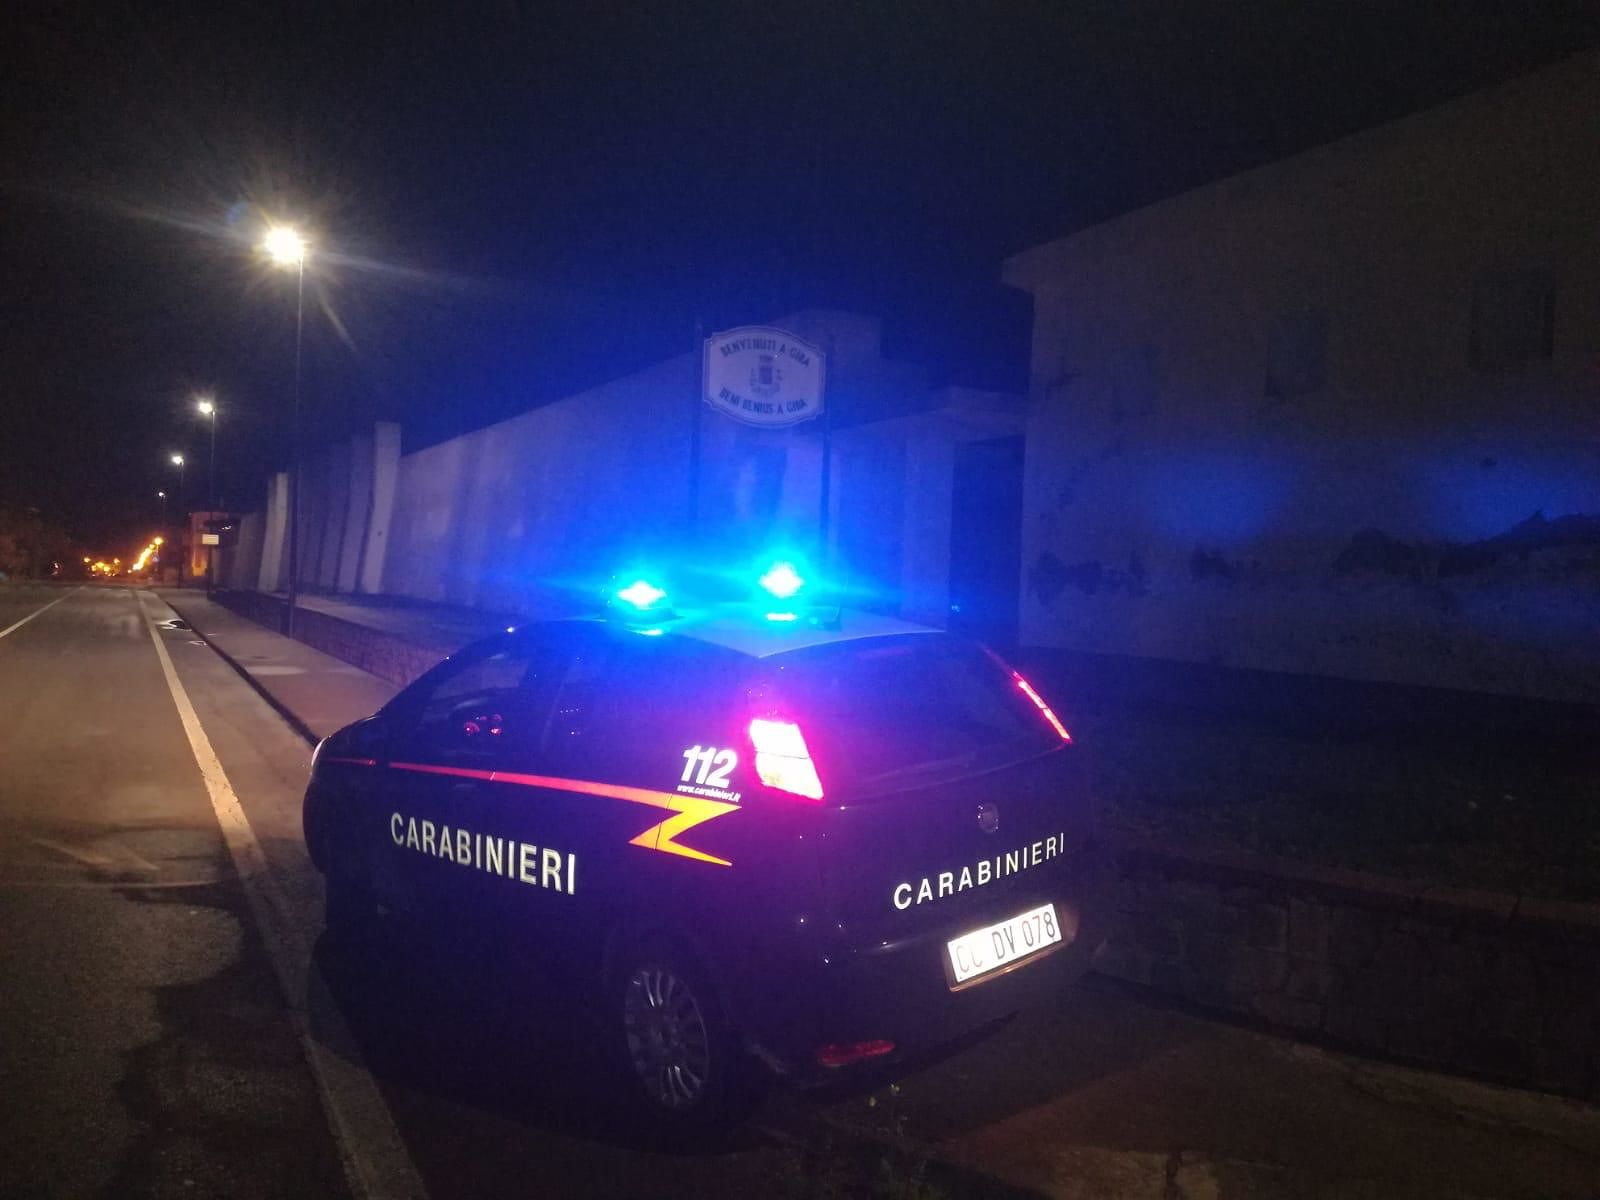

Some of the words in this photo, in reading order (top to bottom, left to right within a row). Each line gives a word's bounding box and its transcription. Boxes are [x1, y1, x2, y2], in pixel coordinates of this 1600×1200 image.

[779, 343, 786, 354] A
[777, 403, 784, 415] A
[681, 745, 738, 789] 112
[391, 812, 576, 895] CARABINIERI
[893, 832, 1064, 910] CARABINIERI
[956, 944, 983, 973] CC
[991, 925, 1016, 960] DV
[1022, 911, 1056, 947] 078
